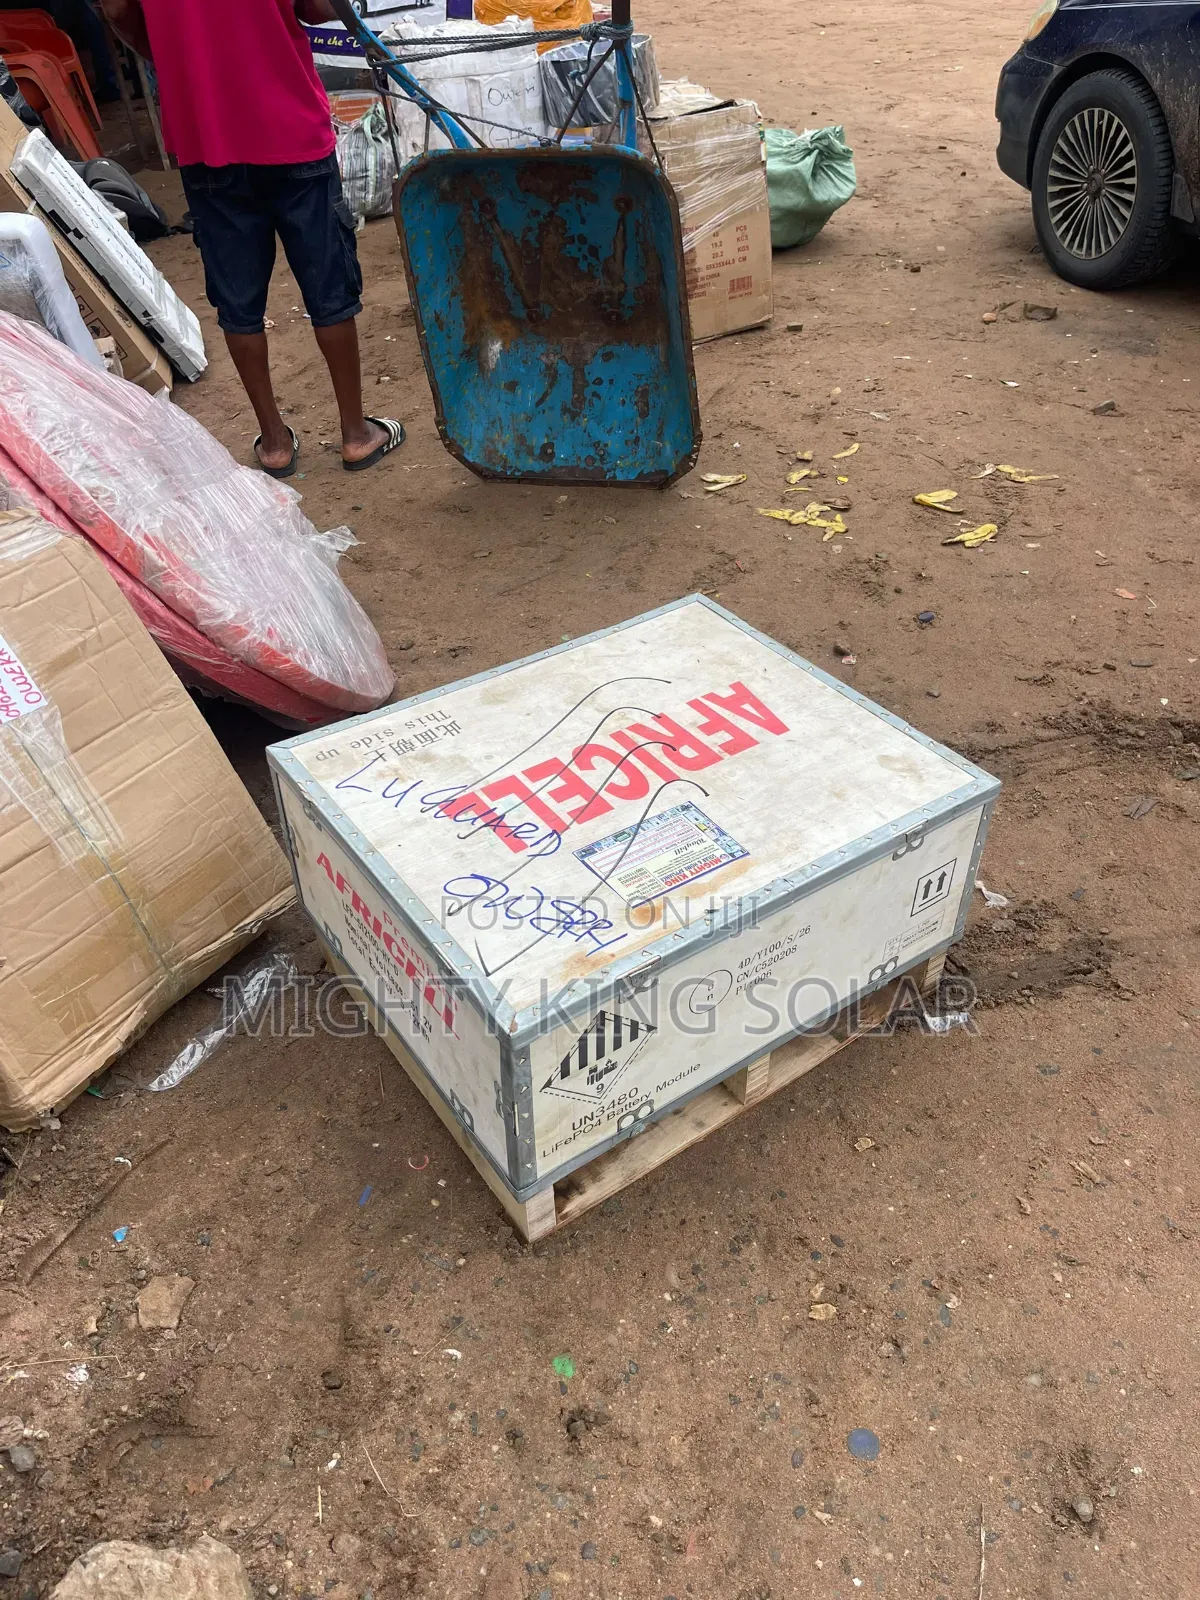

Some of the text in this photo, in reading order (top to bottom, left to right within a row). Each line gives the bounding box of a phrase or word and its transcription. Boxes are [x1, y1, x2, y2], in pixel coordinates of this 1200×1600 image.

[315, 709, 452, 763] This side up
[363, 720, 463, 763] 此面朝上
[438, 681, 791, 854] AFRICELL
[671, 836, 707, 856] Waybill
[686, 856, 723, 876] MIGHTY
[662, 872, 689, 887] KING
[316, 851, 461, 1041] AFRICELL
[543, 1062, 701, 1158] LiFePO4 Battery Module
[571, 1086, 639, 1131] UN3480
